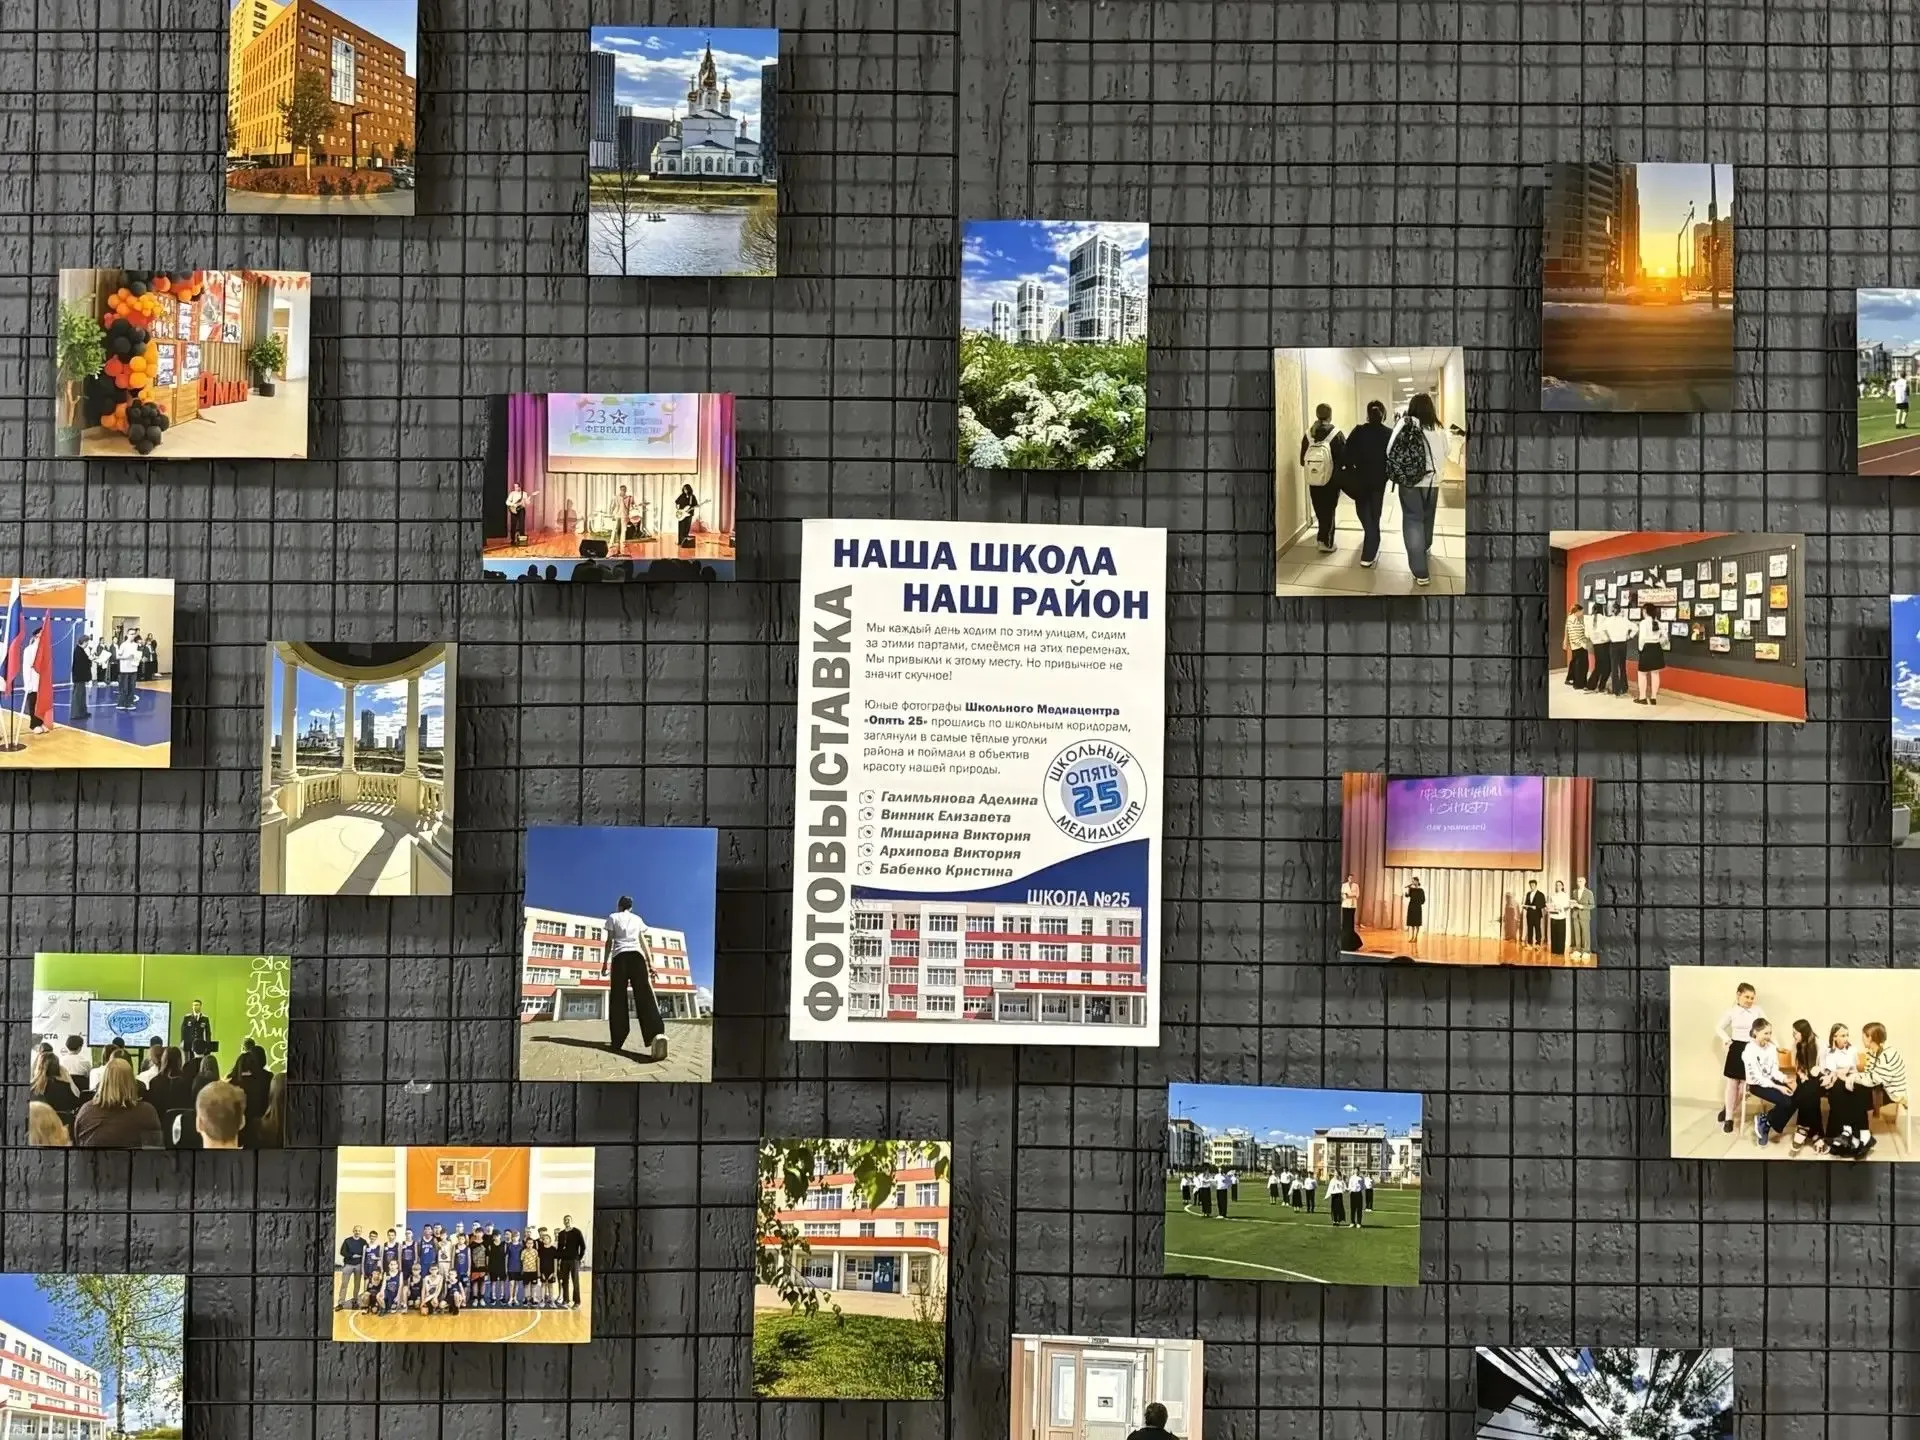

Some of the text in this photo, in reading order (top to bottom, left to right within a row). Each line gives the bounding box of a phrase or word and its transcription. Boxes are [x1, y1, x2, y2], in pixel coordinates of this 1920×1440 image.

[198, 370, 214, 409] 9
[585, 409, 606, 424] 23
[585, 425, 631, 434] ФЕВРАЛЯ
[834, 538, 1118, 576] НАША ШКОЛА
[903, 579, 1148, 619] НАШ РАЙОН
[866, 623, 1126, 640] Мы каждый день ходим по этим улицам, сидим
[866, 640, 878, 648] за
[882, 640, 914, 648] этими
[918, 641, 968, 651] партами,
[971, 641, 1020, 652] смеёмся
[1024, 644, 1036, 652] на
[1040, 644, 1062, 653] этих
[866, 654, 884, 663] Мы
[888, 656, 942, 666] привыкли
[954, 657, 986, 668] этому
[988, 657, 1023, 670] месту.
[1027, 658, 1041, 668] Но
[1045, 660, 1106, 670] привычное
[1110, 662, 1123, 670] не
[865, 671, 952, 682] значит скучное!
[865, 700, 1120, 717] Юные фотографы Школьного Медиацентра
[932, 718, 986, 728] прошлись
[989, 720, 1002, 728] по
[1005, 721, 1063, 730] школьным
[1067, 722, 1131, 732] коридорам,
[864, 732, 916, 743] заглянули
[930, 734, 967, 742] самые
[970, 733, 1009, 743] тёплые
[1012, 736, 1047, 745] уголки
[864, 746, 904, 757] района
[918, 748, 966, 757] поймали
[970, 750, 975, 758] в
[979, 749, 1029, 760] объектив
[864, 763, 1000, 775] красоту нашей природы.
[1049, 744, 1130, 781] ШКОЛЬНЫЙ
[1066, 765, 1118, 785] ОПЯТЬ
[803, 584, 853, 1022] ФОТОВЫСТАВКА
[881, 791, 1038, 806] Галимьянова Аделина
[1072, 780, 1122, 817] 25
[881, 809, 1011, 823] Винник Елизавета
[1057, 801, 1141, 840] МЕДИАЦЕНТР
[880, 827, 1031, 843] Мишарина Виктория
[880, 845, 1021, 861] Архипова Виктория
[880, 864, 1013, 878] Бабенко Кристина
[1027, 889, 1130, 907] ШКОЛА №25
